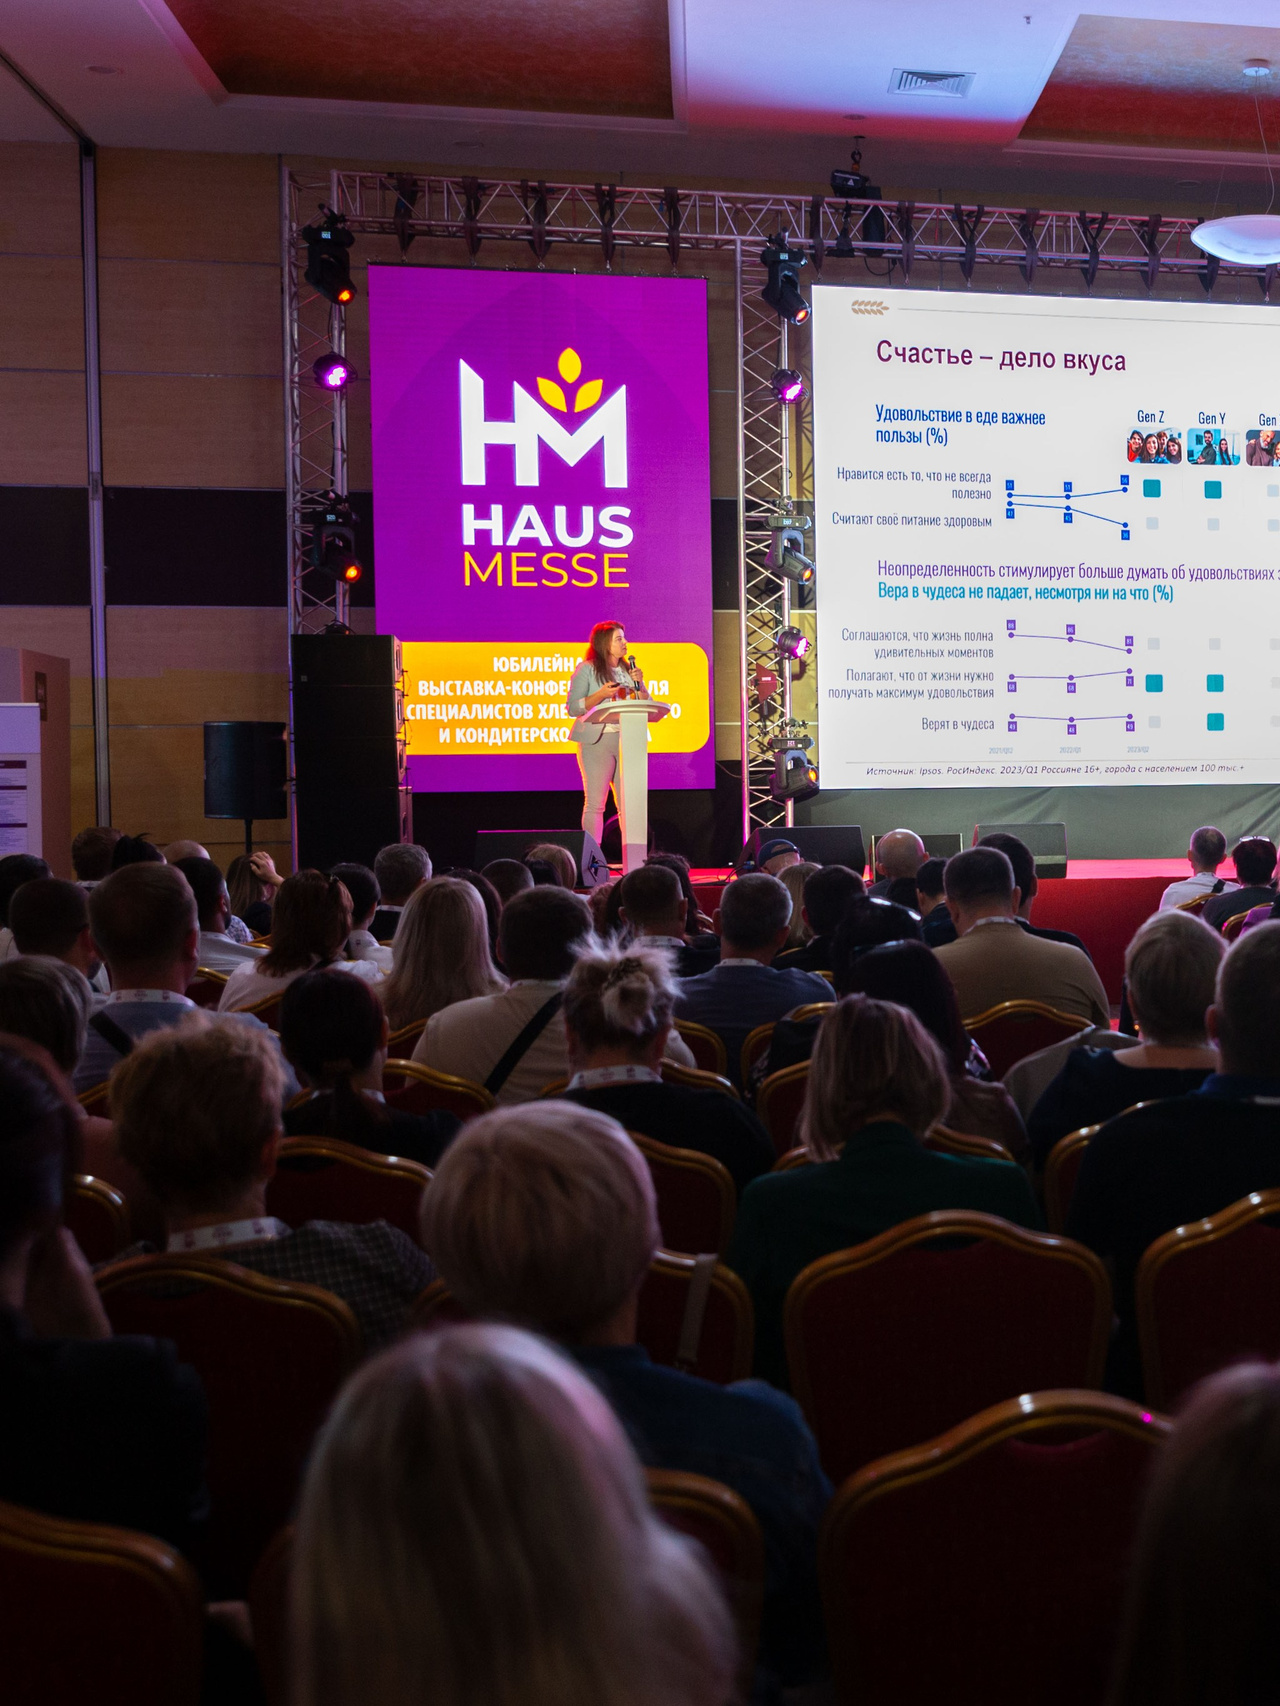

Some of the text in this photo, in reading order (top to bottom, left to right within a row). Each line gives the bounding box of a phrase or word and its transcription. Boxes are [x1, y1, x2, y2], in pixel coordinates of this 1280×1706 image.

[876, 340, 973, 365] Счастье
[1000, 351, 1056, 370] дело
[1064, 354, 1126, 376] вкуса
[876, 404, 1046, 425] Удовольствие в еде важнее
[1137, 410, 1164, 423] Gen Z
[1198, 412, 1226, 424] Gen Y
[1259, 414, 1277, 426] Gen
[876, 428, 948, 446] пользы (%)
[837, 467, 992, 483] Нравится есть то, что не всегда
[952, 490, 992, 499] полезно
[462, 504, 634, 547] HAUS
[832, 512, 992, 528] Считают своё питание здоровым
[463, 552, 630, 587] MESSE
[878, 560, 995, 579] Неопределенность
[999, 566, 1075, 581] стимулирует
[1079, 563, 1124, 578] больше
[1127, 568, 1168, 581] думать
[1171, 564, 1186, 579] об
[1189, 568, 1275, 582] удовольствиях
[878, 582, 1174, 603] Вера в чудеса не падает, несмотря ни на что (%)
[842, 628, 993, 641] Соглашаются, что жизнь полна
[874, 649, 994, 659] удивительных моментов
[494, 654, 584, 672] ЮБИЛЕЙН
[846, 669, 994, 683] Полагают, что от жизни нужно
[418, 680, 570, 697] ВЫСТАВКА-КОНФЕ
[828, 689, 994, 700] получать максимум удовольствия
[406, 704, 534, 722] СПЕЦИАЛИСТОВ
[922, 718, 995, 732] Верят в чудеса
[439, 727, 570, 746] И КОНДИТЕРСКО
[919, 768, 944, 776] Ipsos.
[1000, 766, 1038, 774] 2023/Q1
[1084, 766, 1102, 774] 16+,
[1104, 765, 1135, 774] города
[1200, 764, 1216, 772] 100
